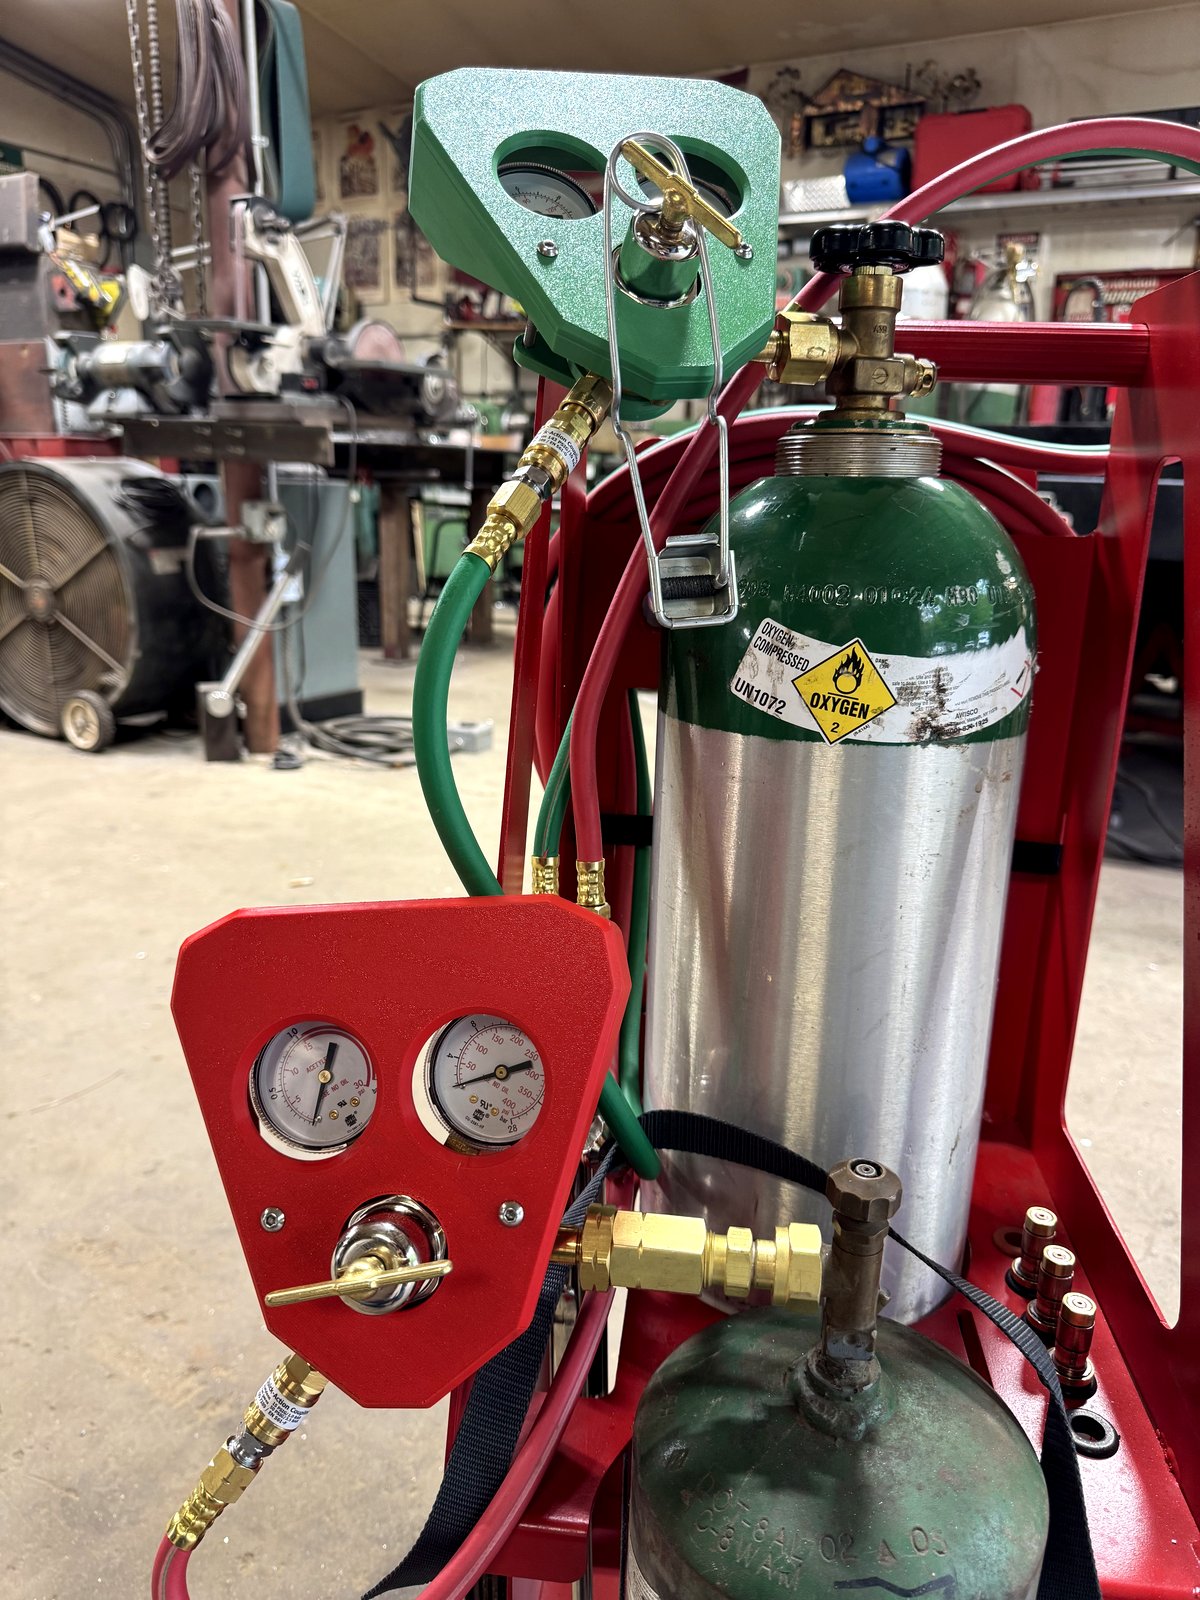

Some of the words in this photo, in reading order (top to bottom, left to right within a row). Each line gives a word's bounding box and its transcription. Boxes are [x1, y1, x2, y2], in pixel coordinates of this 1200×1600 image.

[761, 621, 795, 647] OXYGEN
[753, 636, 811, 672] COMPRESSED
[734, 678, 787, 716] UN1072
[809, 692, 871, 720] OXYGEN
[830, 722, 840, 733] 2
[286, 1027, 299, 1039] 1.0
[491, 1033, 505, 1045] 150
[510, 1034, 525, 1047] 200
[475, 1043, 489, 1055] 100
[524, 1048, 539, 1061] 250
[291, 1067, 299, 1077] 10
[465, 1062, 477, 1071] 50
[525, 1069, 540, 1081] 300
[353, 1079, 364, 1090] 30
[517, 1085, 533, 1099] 350
[295, 1095, 302, 1103] 5
[502, 1097, 516, 1109] 400
[507, 1124, 518, 1134] 28
